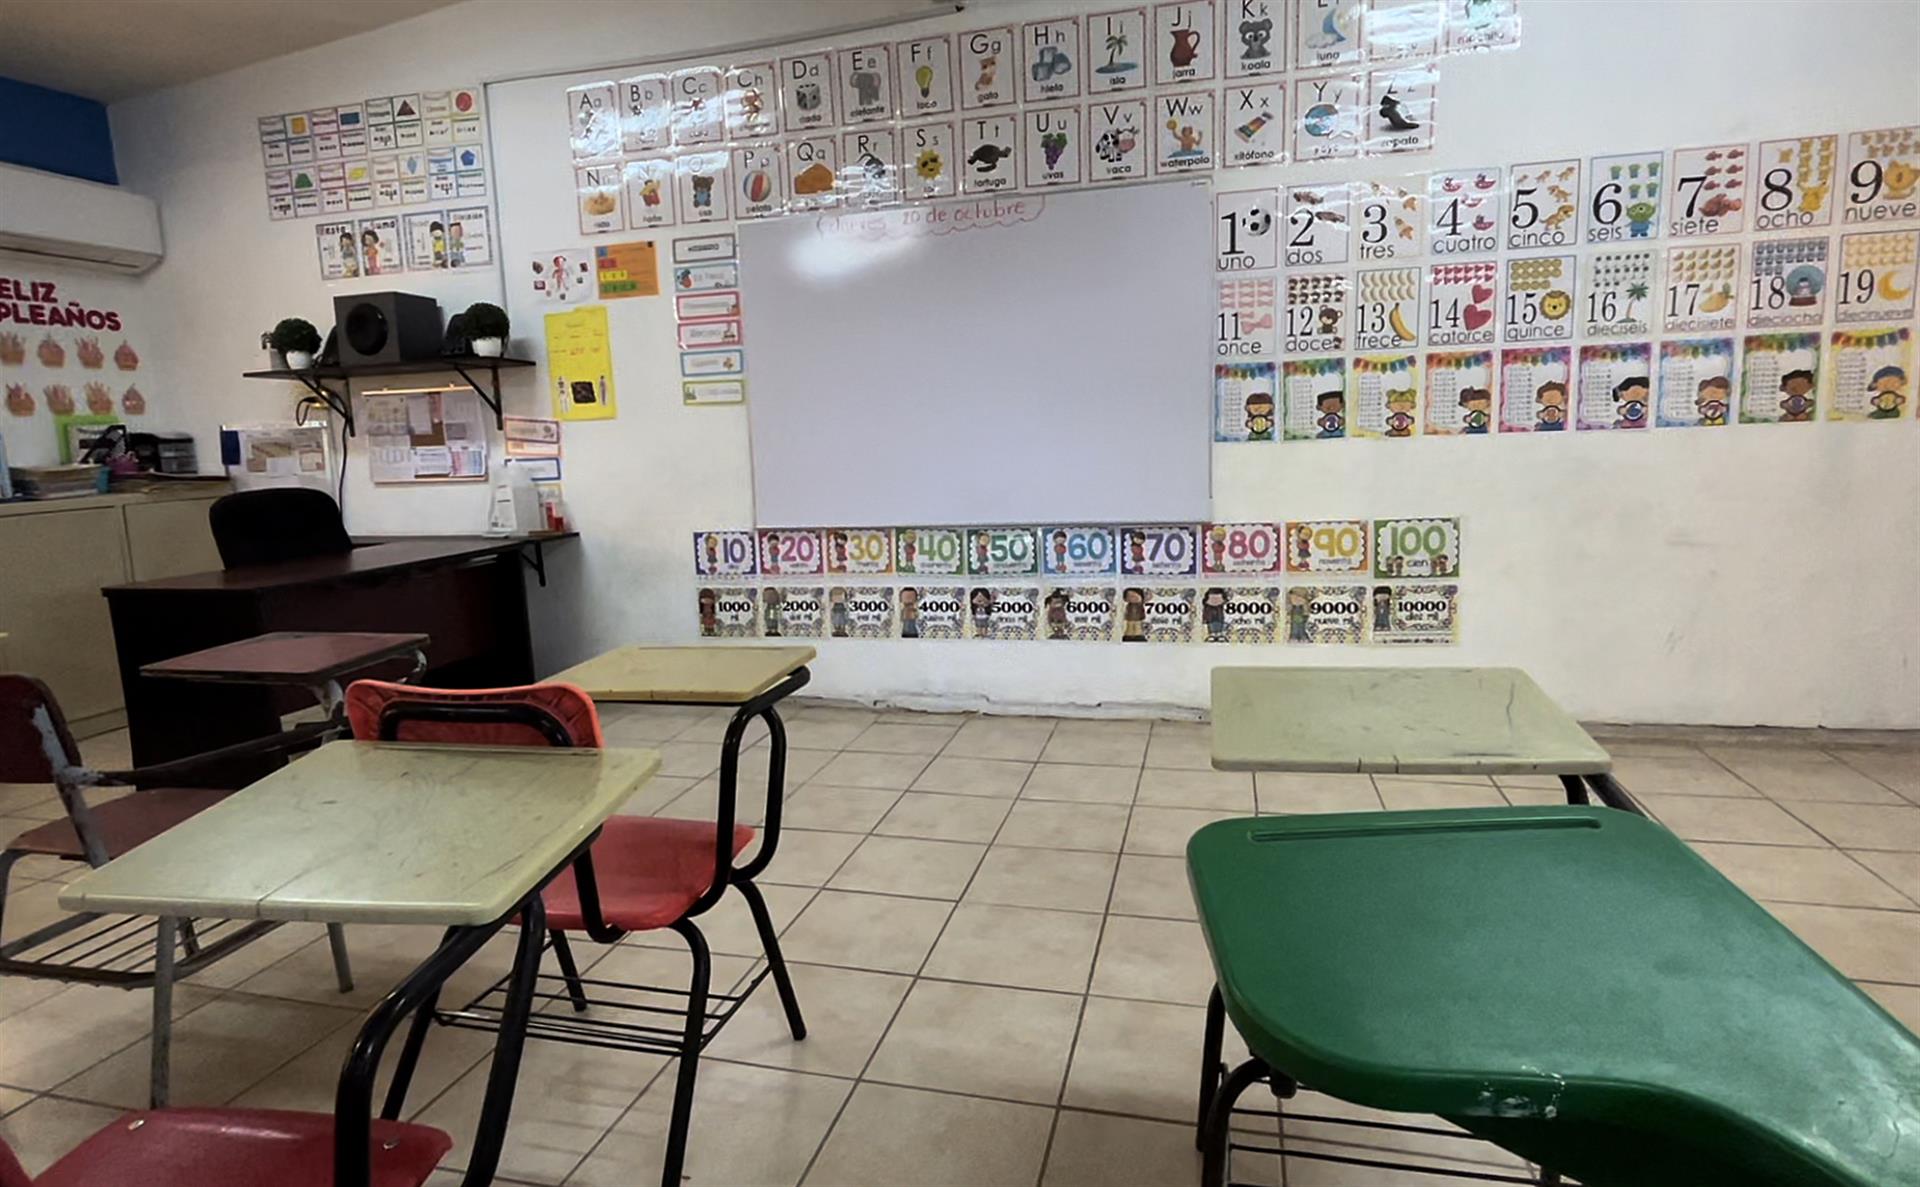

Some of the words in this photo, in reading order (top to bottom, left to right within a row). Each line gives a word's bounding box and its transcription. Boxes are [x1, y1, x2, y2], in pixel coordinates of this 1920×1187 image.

[1241, 60, 1271, 71] koala
[1317, 52, 1340, 60] luna
[1173, 68, 1195, 79] jarra
[1106, 165, 1131, 174] vaca
[1160, 156, 1210, 168] waterpolo
[974, 177, 1007, 188] tortuga
[1042, 171, 1064, 180] uvas
[1850, 159, 1884, 204] 9
[1677, 176, 1707, 218] 7
[1761, 168, 1793, 211] 8
[1511, 187, 1539, 230] 5
[1592, 183, 1622, 225] 6
[1845, 202, 1916, 221] nueve
[926, 207, 947, 222] de
[1362, 204, 1388, 243] 3
[1436, 198, 1463, 236] 4
[1756, 209, 1814, 229] ocho
[1220, 212, 1245, 256] 1
[1289, 208, 1315, 247] 2
[1587, 223, 1622, 242] seis
[1671, 218, 1718, 236] siete
[1432, 234, 1496, 254] cuatro
[1508, 230, 1565, 248] cinco
[1287, 250, 1323, 265] dos
[1359, 243, 1395, 260] tres
[1218, 255, 1255, 270] uno
[1751, 276, 1785, 310] 18
[1838, 269, 1875, 305] 19
[1507, 293, 1537, 325] 15
[1587, 291, 1617, 323] 16
[1667, 283, 1700, 317] 17
[1287, 306, 1313, 338] 12
[1357, 302, 1385, 334] 13
[1431, 298, 1460, 329] 14
[1218, 312, 1242, 341] 11
[1429, 326, 1494, 345] catorce
[1507, 322, 1565, 342] quince
[1217, 341, 1262, 356] once
[1285, 336, 1332, 352] doce
[1356, 333, 1401, 349] trece
[723, 538, 745, 563] 10
[781, 536, 814, 562] 20
[850, 535, 883, 561] 30
[918, 535, 956, 562] 40
[991, 535, 1028, 561] 50
[1068, 533, 1108, 561] 60
[1147, 533, 1186, 562] 70
[1228, 530, 1271, 559] 80
[1314, 528, 1359, 557] 90
[1390, 525, 1446, 556] 100
[1407, 559, 1428, 568] cien
[718, 601, 750, 612] 1000
[782, 601, 819, 612] 2000
[850, 601, 888, 612] 3000
[919, 601, 960, 613] 4000
[991, 602, 1033, 613] 5000
[1066, 602, 1110, 613] 6000
[1145, 602, 1189, 615] 7000
[1225, 602, 1272, 615] 8000
[1310, 602, 1359, 615] 9000
[1398, 601, 1446, 612] 10000
